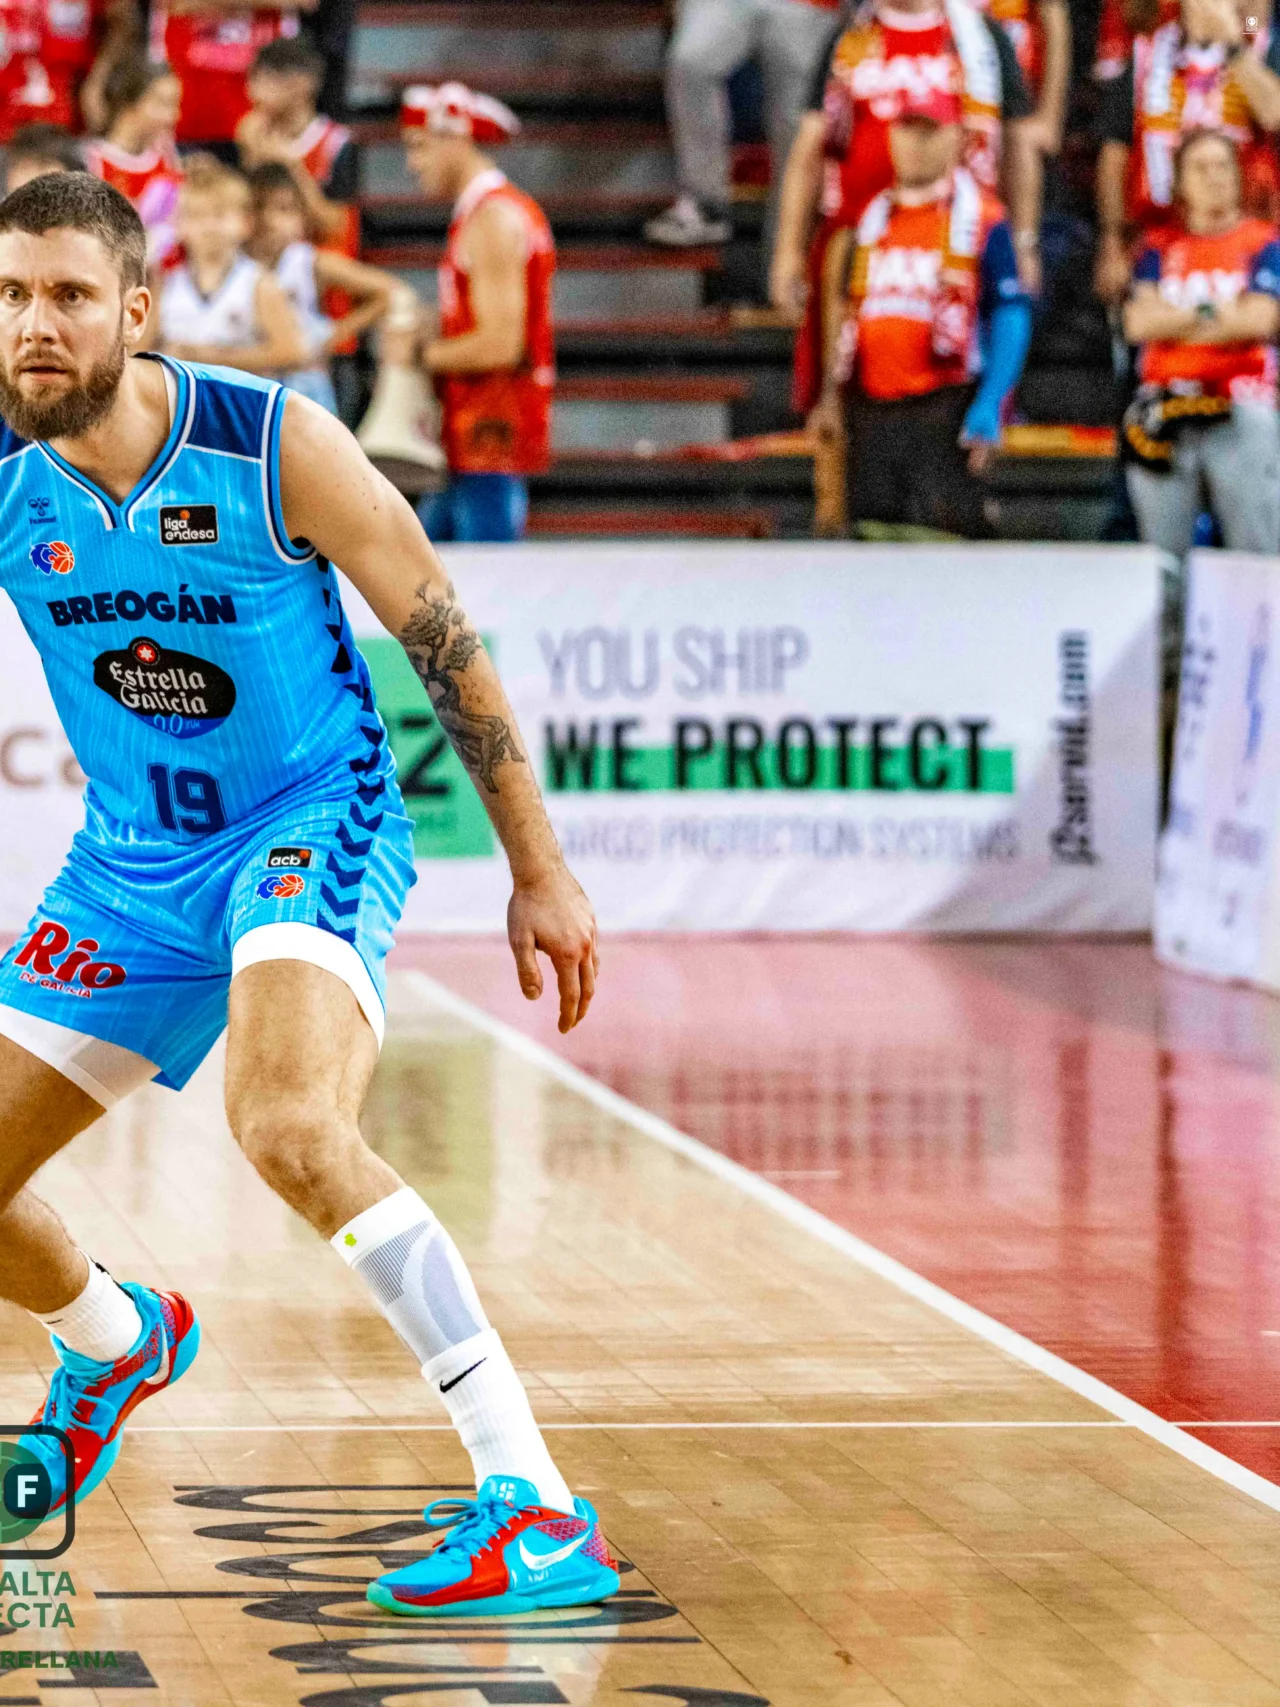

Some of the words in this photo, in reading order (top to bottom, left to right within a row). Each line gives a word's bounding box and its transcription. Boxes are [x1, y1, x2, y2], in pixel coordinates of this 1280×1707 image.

[164, 517, 188, 531] liga
[165, 528, 215, 541] endesa
[46, 584, 237, 627] BREOGÁN
[109, 660, 207, 691] Estrella
[538, 624, 662, 700] YOU
[672, 624, 809, 700] SHIP
[120, 683, 208, 714] Galicia
[541, 715, 649, 793] WE
[670, 715, 993, 793] PROTECT
[146, 762, 228, 835] 19
[270, 854, 301, 866] acb
